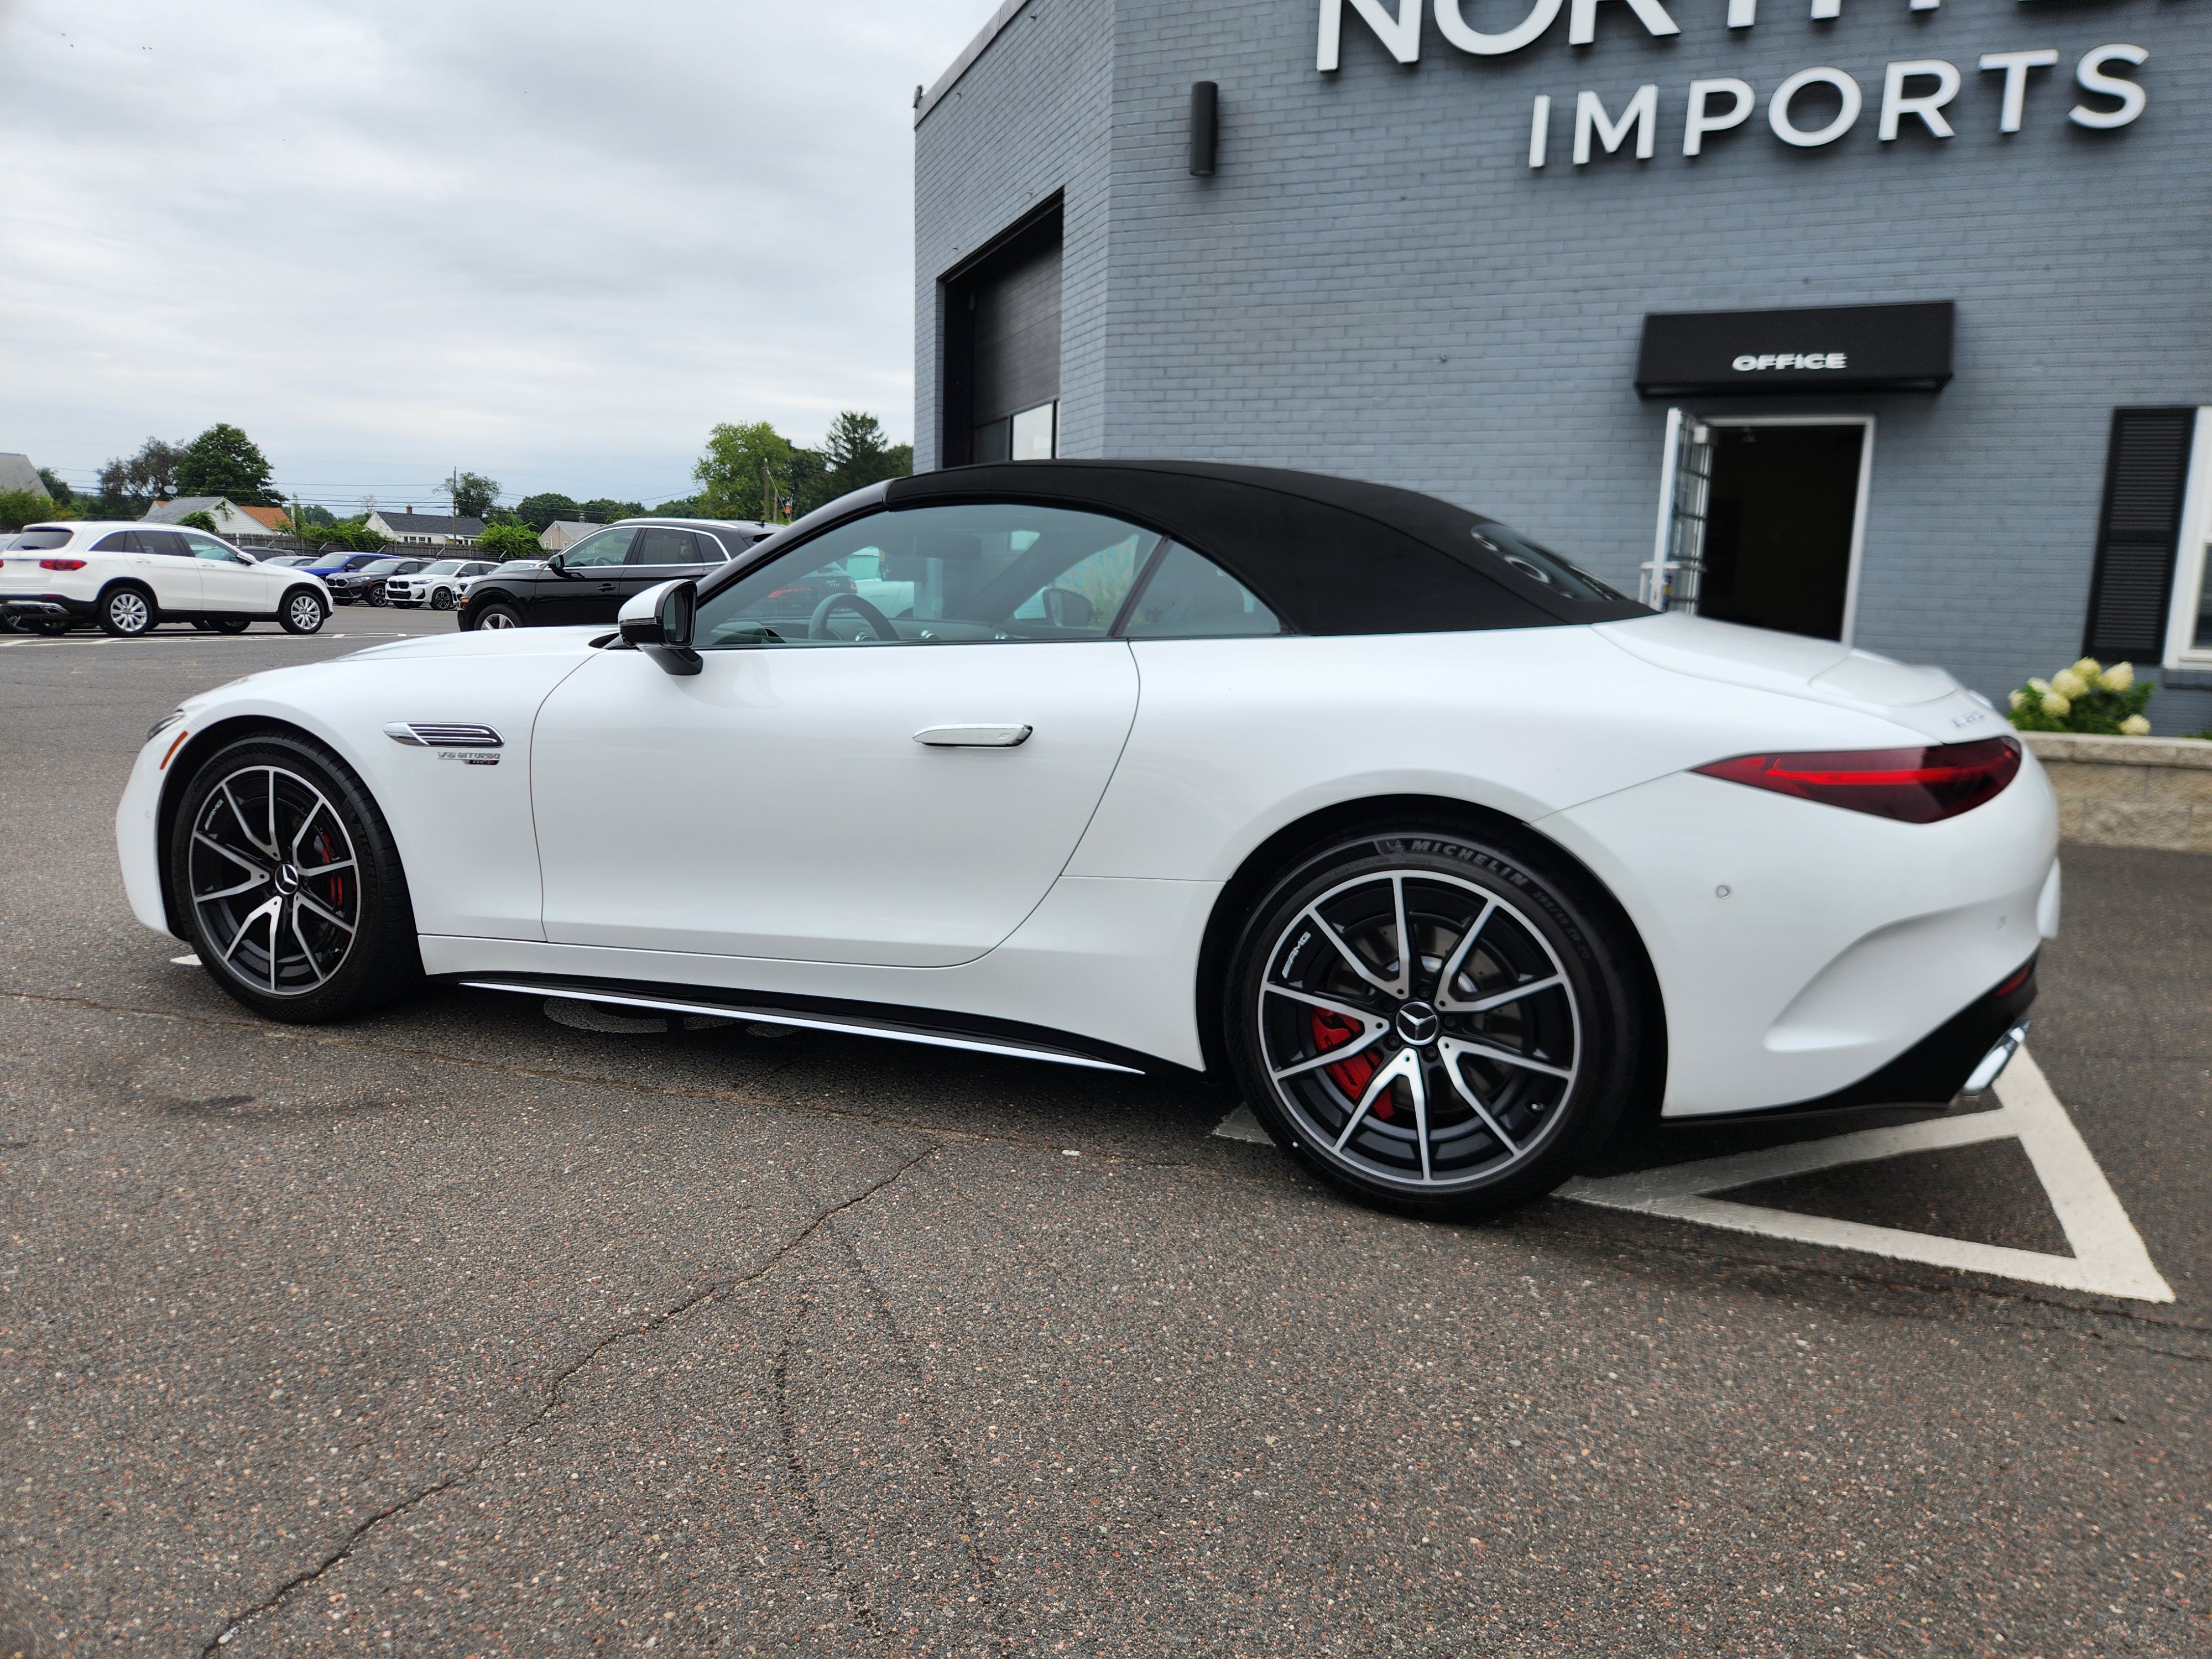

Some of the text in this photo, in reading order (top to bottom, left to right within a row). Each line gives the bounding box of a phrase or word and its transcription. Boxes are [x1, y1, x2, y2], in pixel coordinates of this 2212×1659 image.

[1528, 43, 2151, 168] IMPORTS
[1732, 353, 1848, 371] OFFICE
[1411, 839, 1528, 886] MICHELIN
